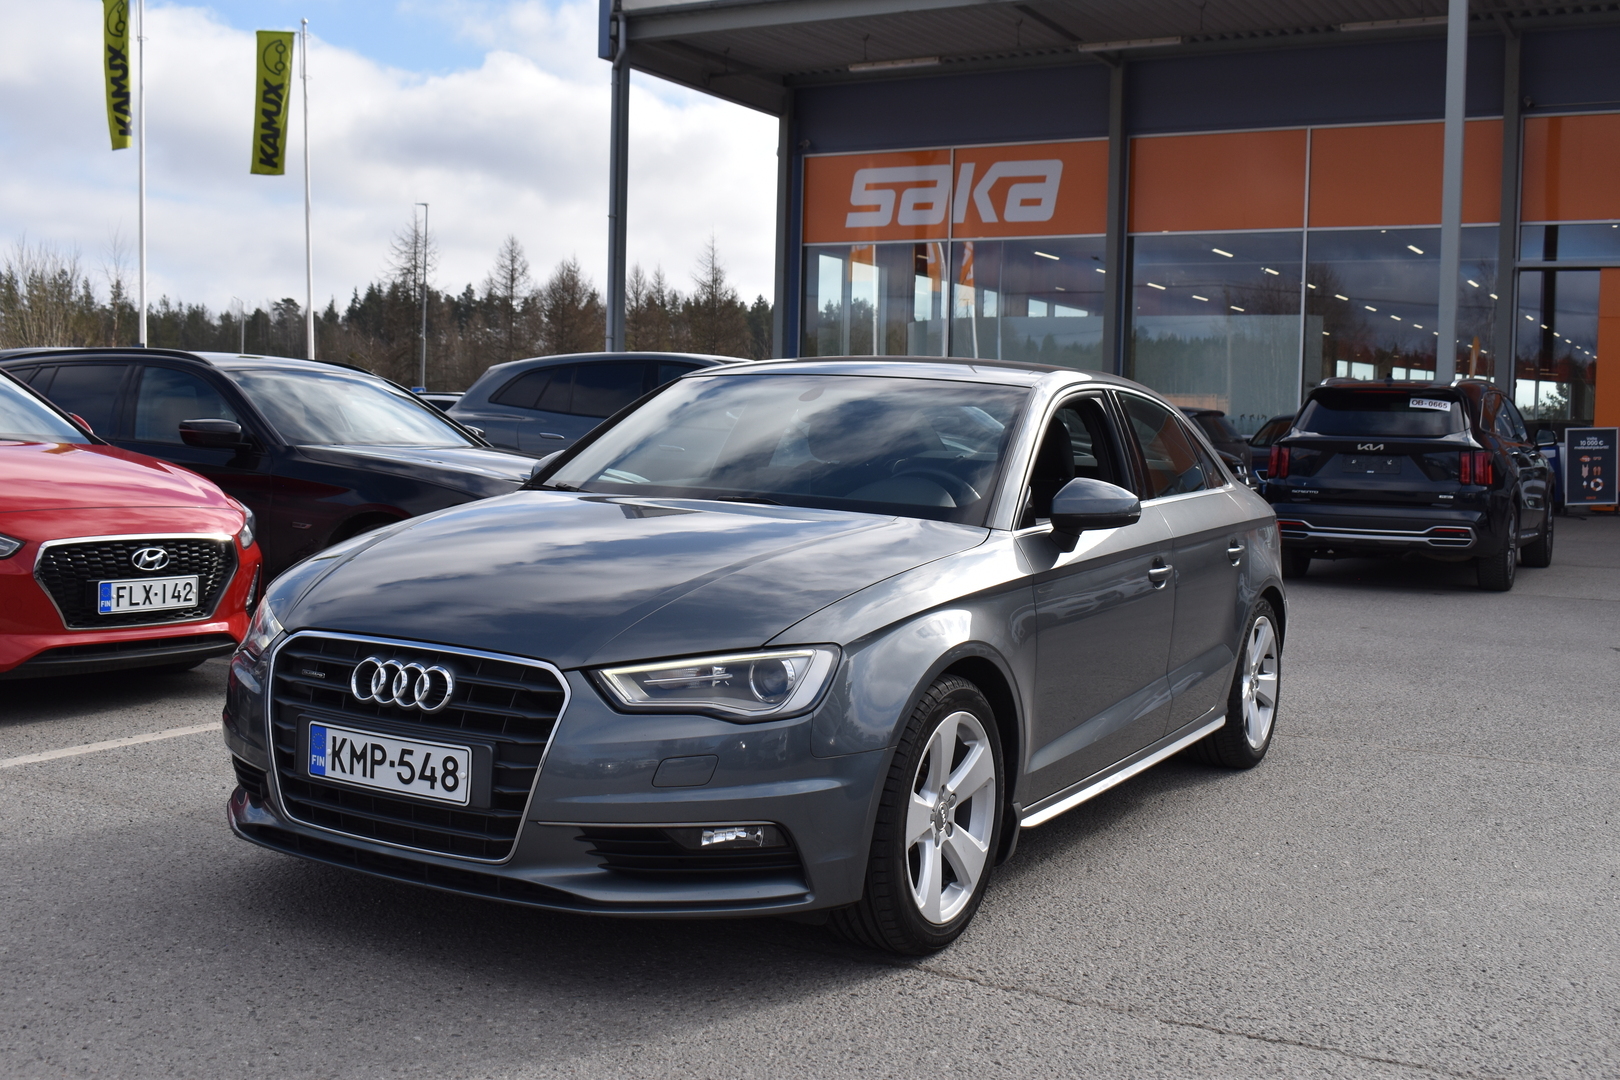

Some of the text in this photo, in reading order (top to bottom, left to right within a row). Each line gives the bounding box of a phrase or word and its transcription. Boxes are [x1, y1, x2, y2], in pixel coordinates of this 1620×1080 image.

[107, 43, 132, 136] KAMUX
[259, 77, 285, 169] KAMUX
[1411, 399, 1448, 409] OB-0665
[1357, 443, 1384, 451] KIA
[100, 582, 193, 608] FIN FLX-142
[311, 736, 459, 792] FIN KMP-548
